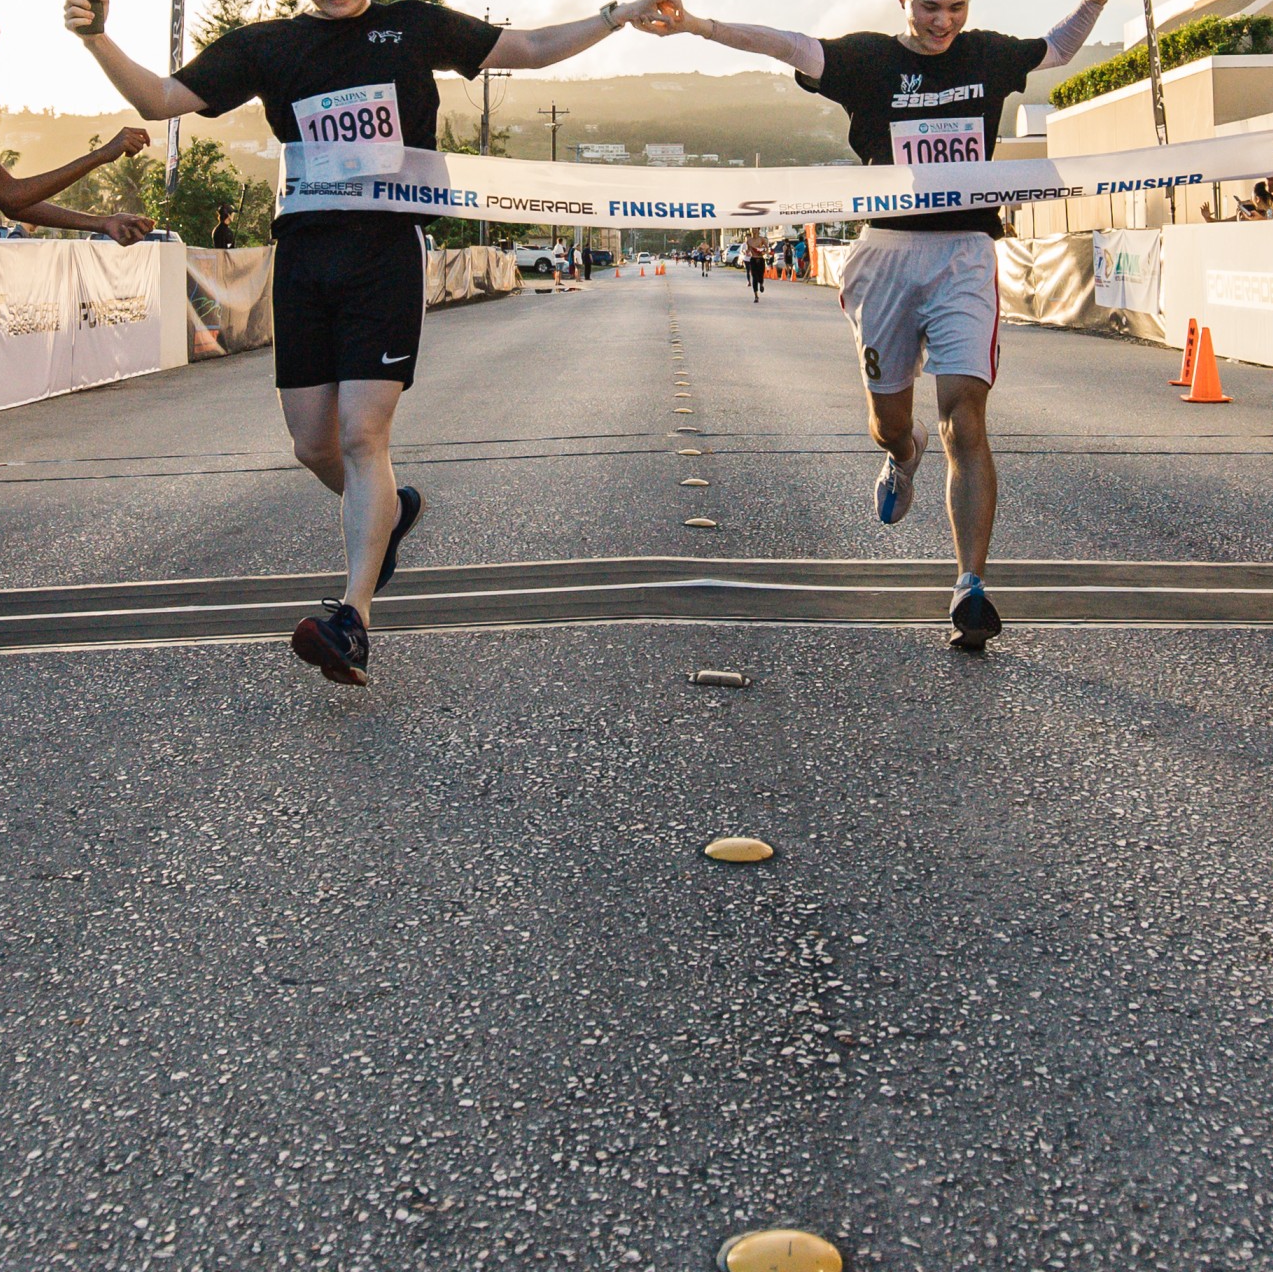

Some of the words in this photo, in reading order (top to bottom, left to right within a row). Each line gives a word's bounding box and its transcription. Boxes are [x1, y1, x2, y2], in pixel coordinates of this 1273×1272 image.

[333, 91, 367, 103] SAIPAN
[308, 106, 393, 142] 10988
[930, 122, 959, 130] SAIPAN
[902, 137, 979, 165] 10866
[299, 189, 362, 197] PERFORMANCE
[300, 181, 363, 191] SKECHERS
[1097, 173, 1203, 195] FINISHER
[373, 181, 479, 208] FINISHER
[852, 190, 962, 213] FINISHER
[970, 186, 1083, 205] POWERADE
[486, 196, 593, 216] POWERADE
[608, 200, 716, 219] FINISHER
[779, 200, 843, 211] SKECHERS
[780, 207, 843, 216] PERFORMANCE
